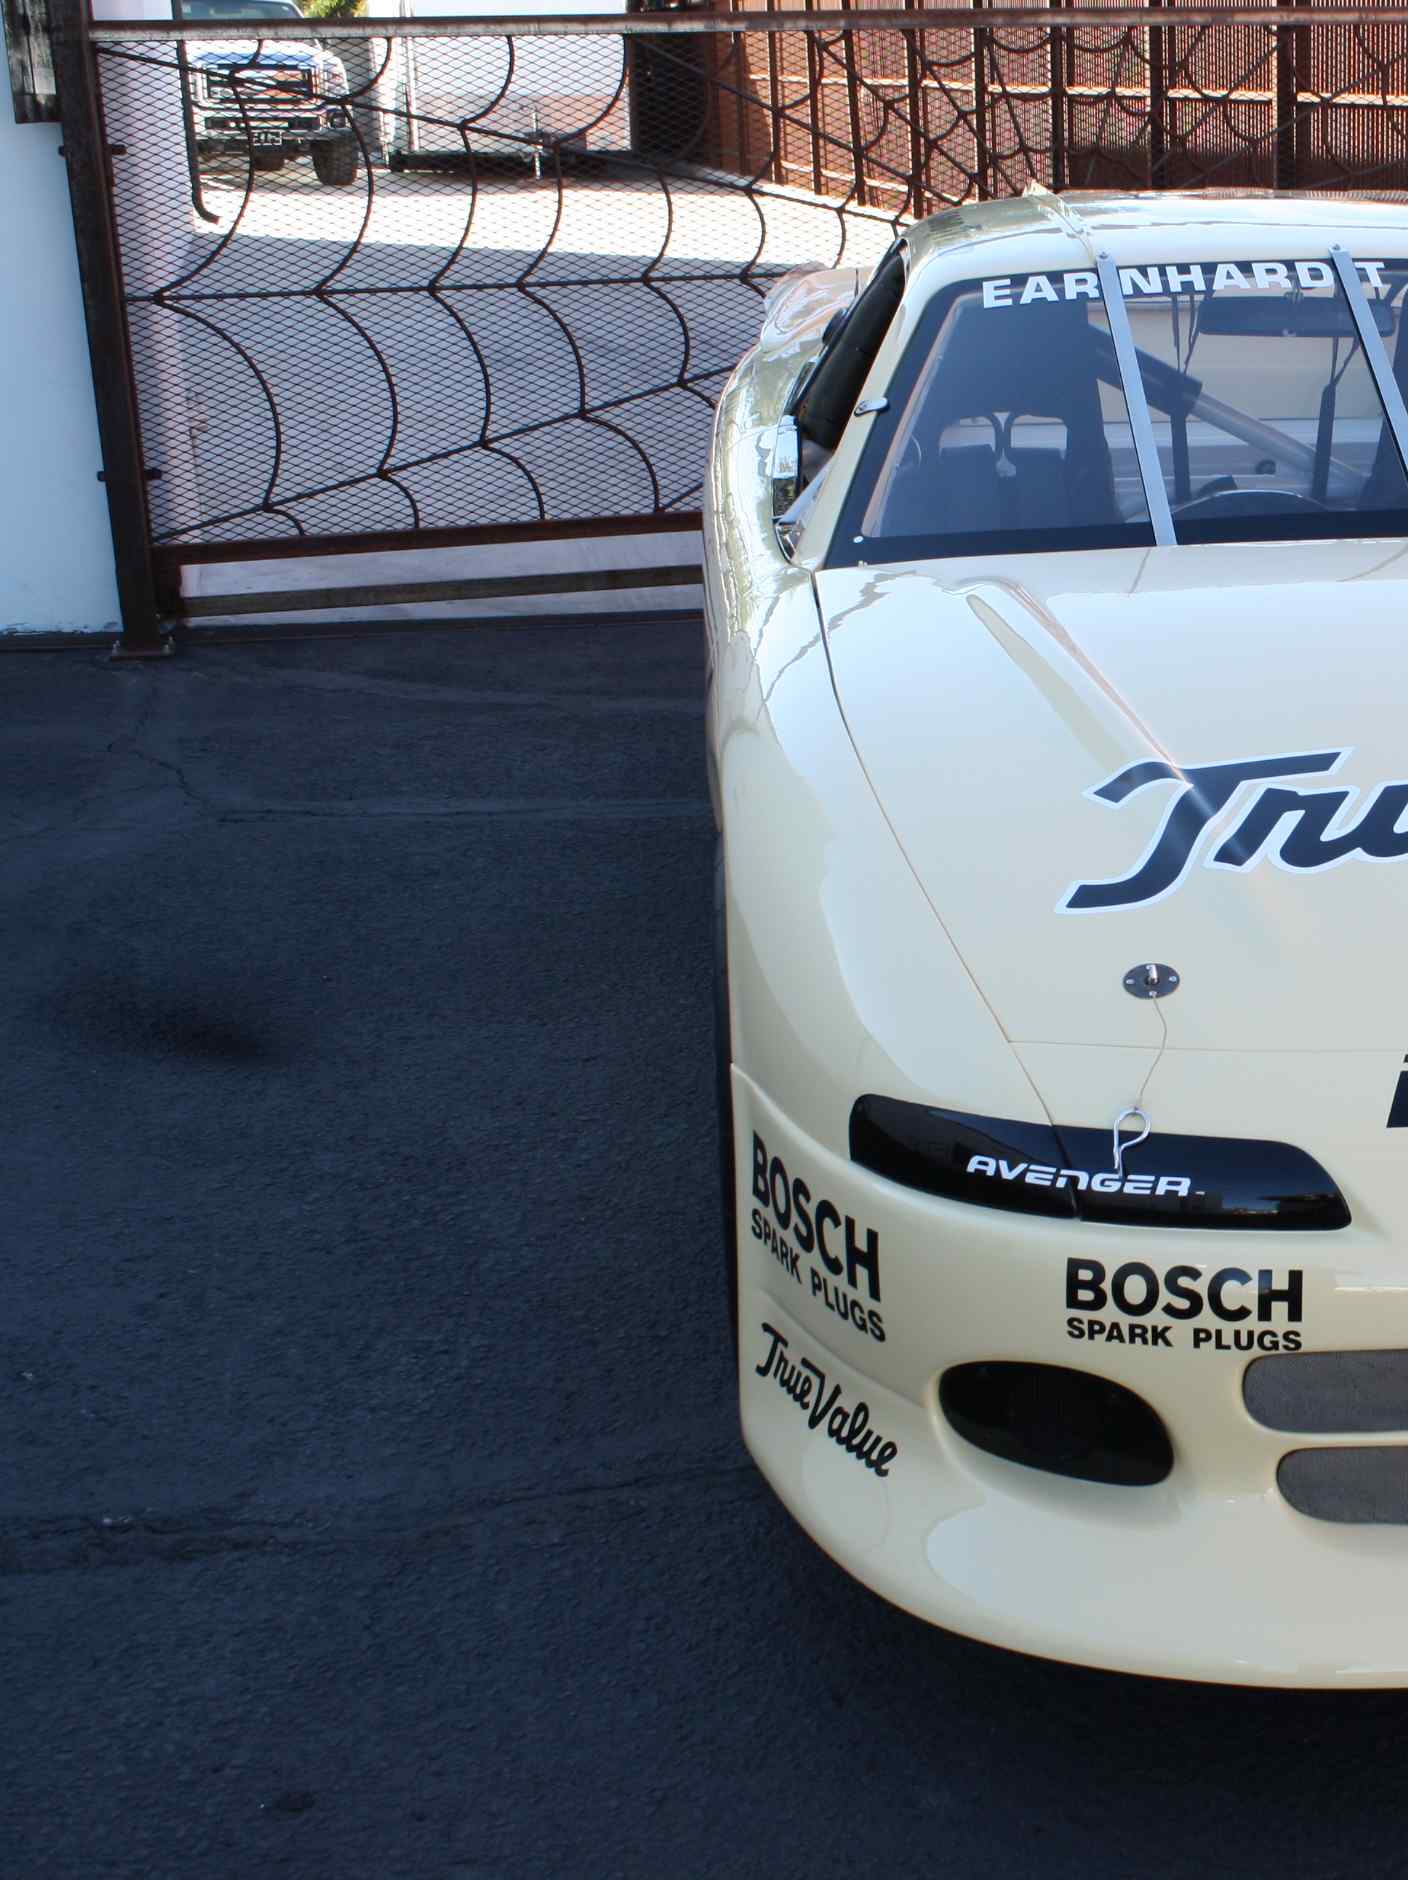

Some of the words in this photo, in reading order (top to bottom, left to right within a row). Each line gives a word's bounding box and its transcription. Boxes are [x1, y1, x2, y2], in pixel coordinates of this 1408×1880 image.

[982, 260, 1386, 309] EARNHARDT
[966, 1155, 1192, 1197] AVENGER
[752, 1130, 881, 1302] BOSCH
[751, 1212, 802, 1284] SPARK
[810, 1273, 887, 1343] PLUGS
[1065, 1257, 1304, 1322] BOSCH
[1066, 1317, 1173, 1348] SPARK
[1192, 1328, 1303, 1352] PLUGS
